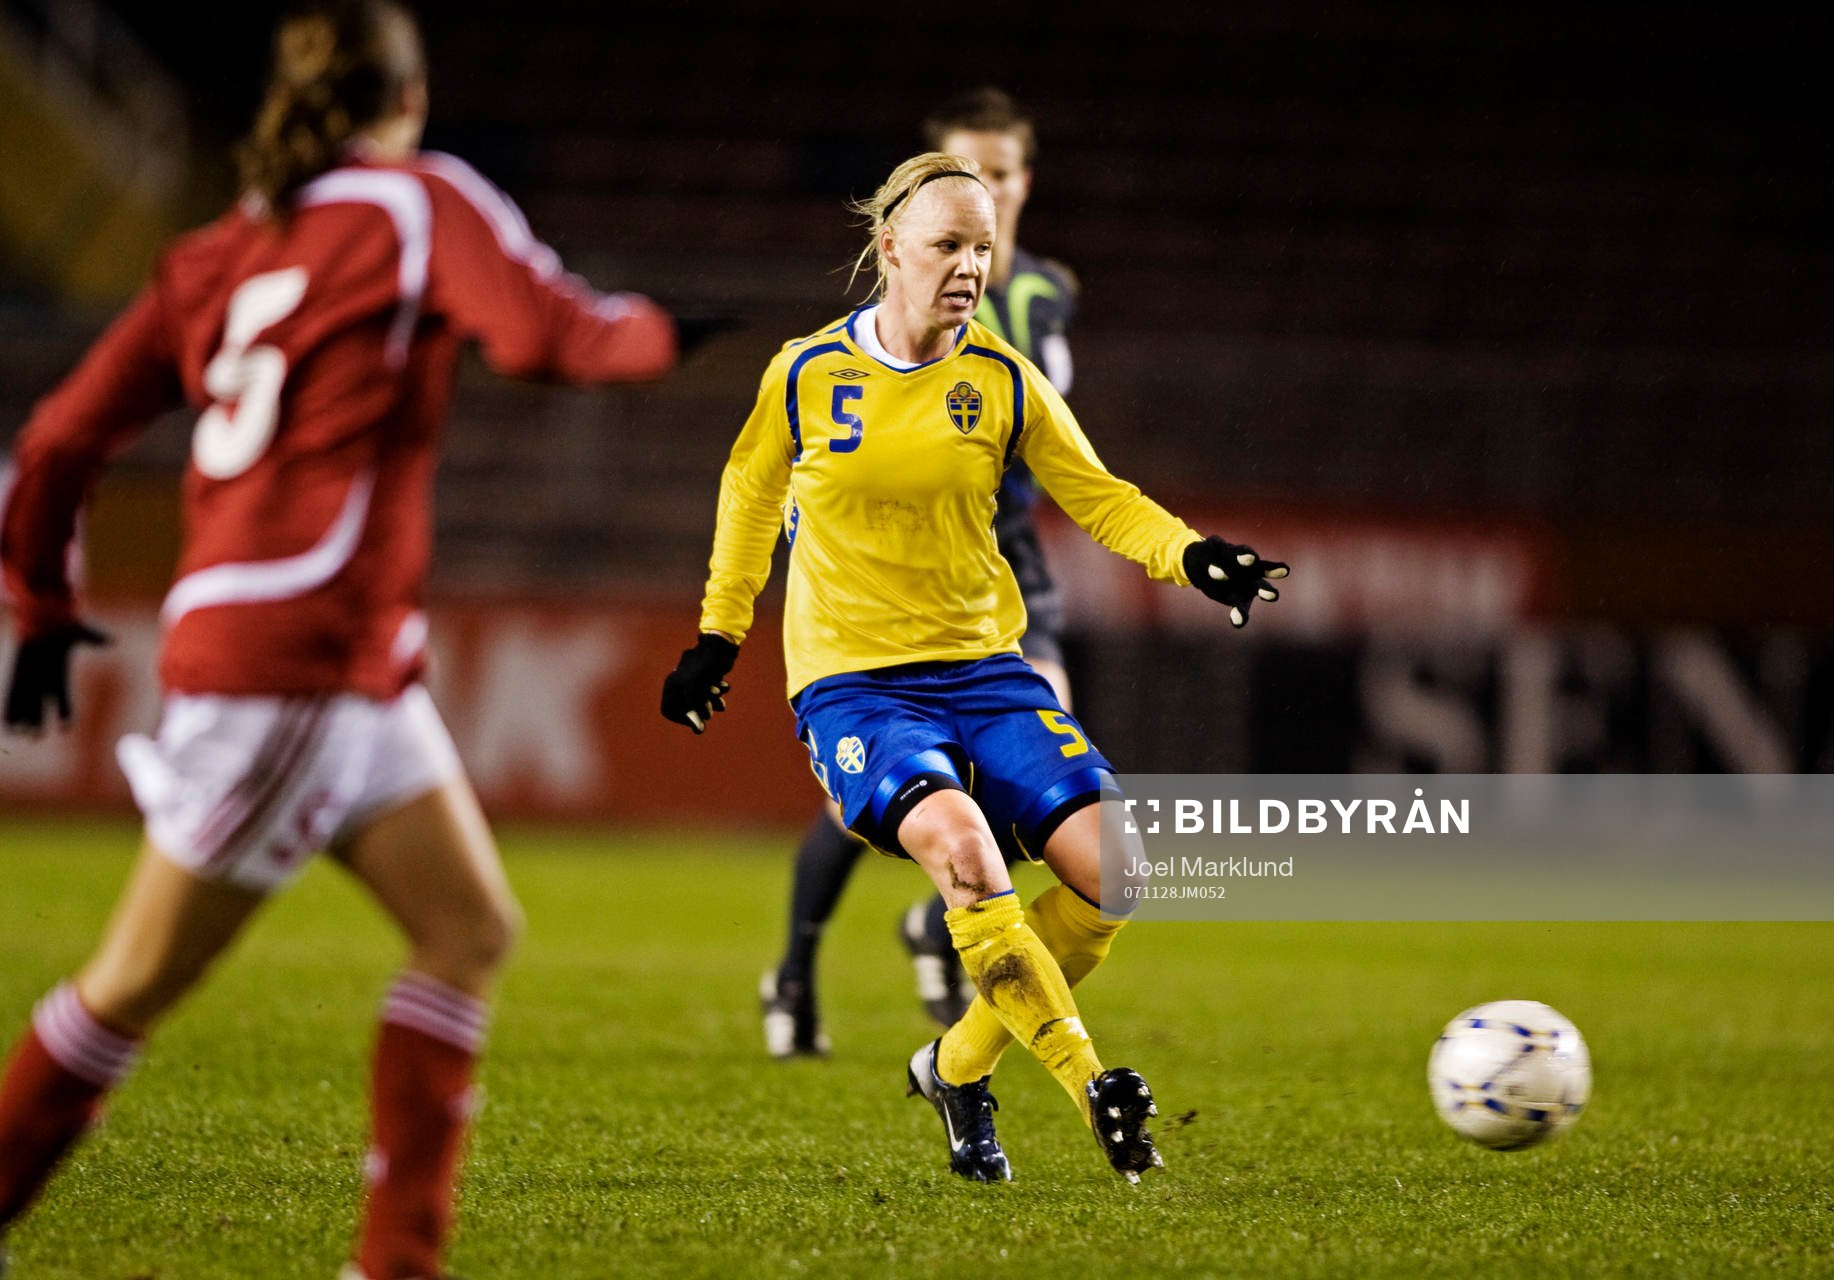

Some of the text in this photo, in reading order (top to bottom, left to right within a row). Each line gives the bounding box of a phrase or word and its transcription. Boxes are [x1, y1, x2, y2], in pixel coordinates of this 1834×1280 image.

[193, 267, 309, 479] 5
[829, 385, 863, 453] 5
[1036, 709, 1089, 758] 5
